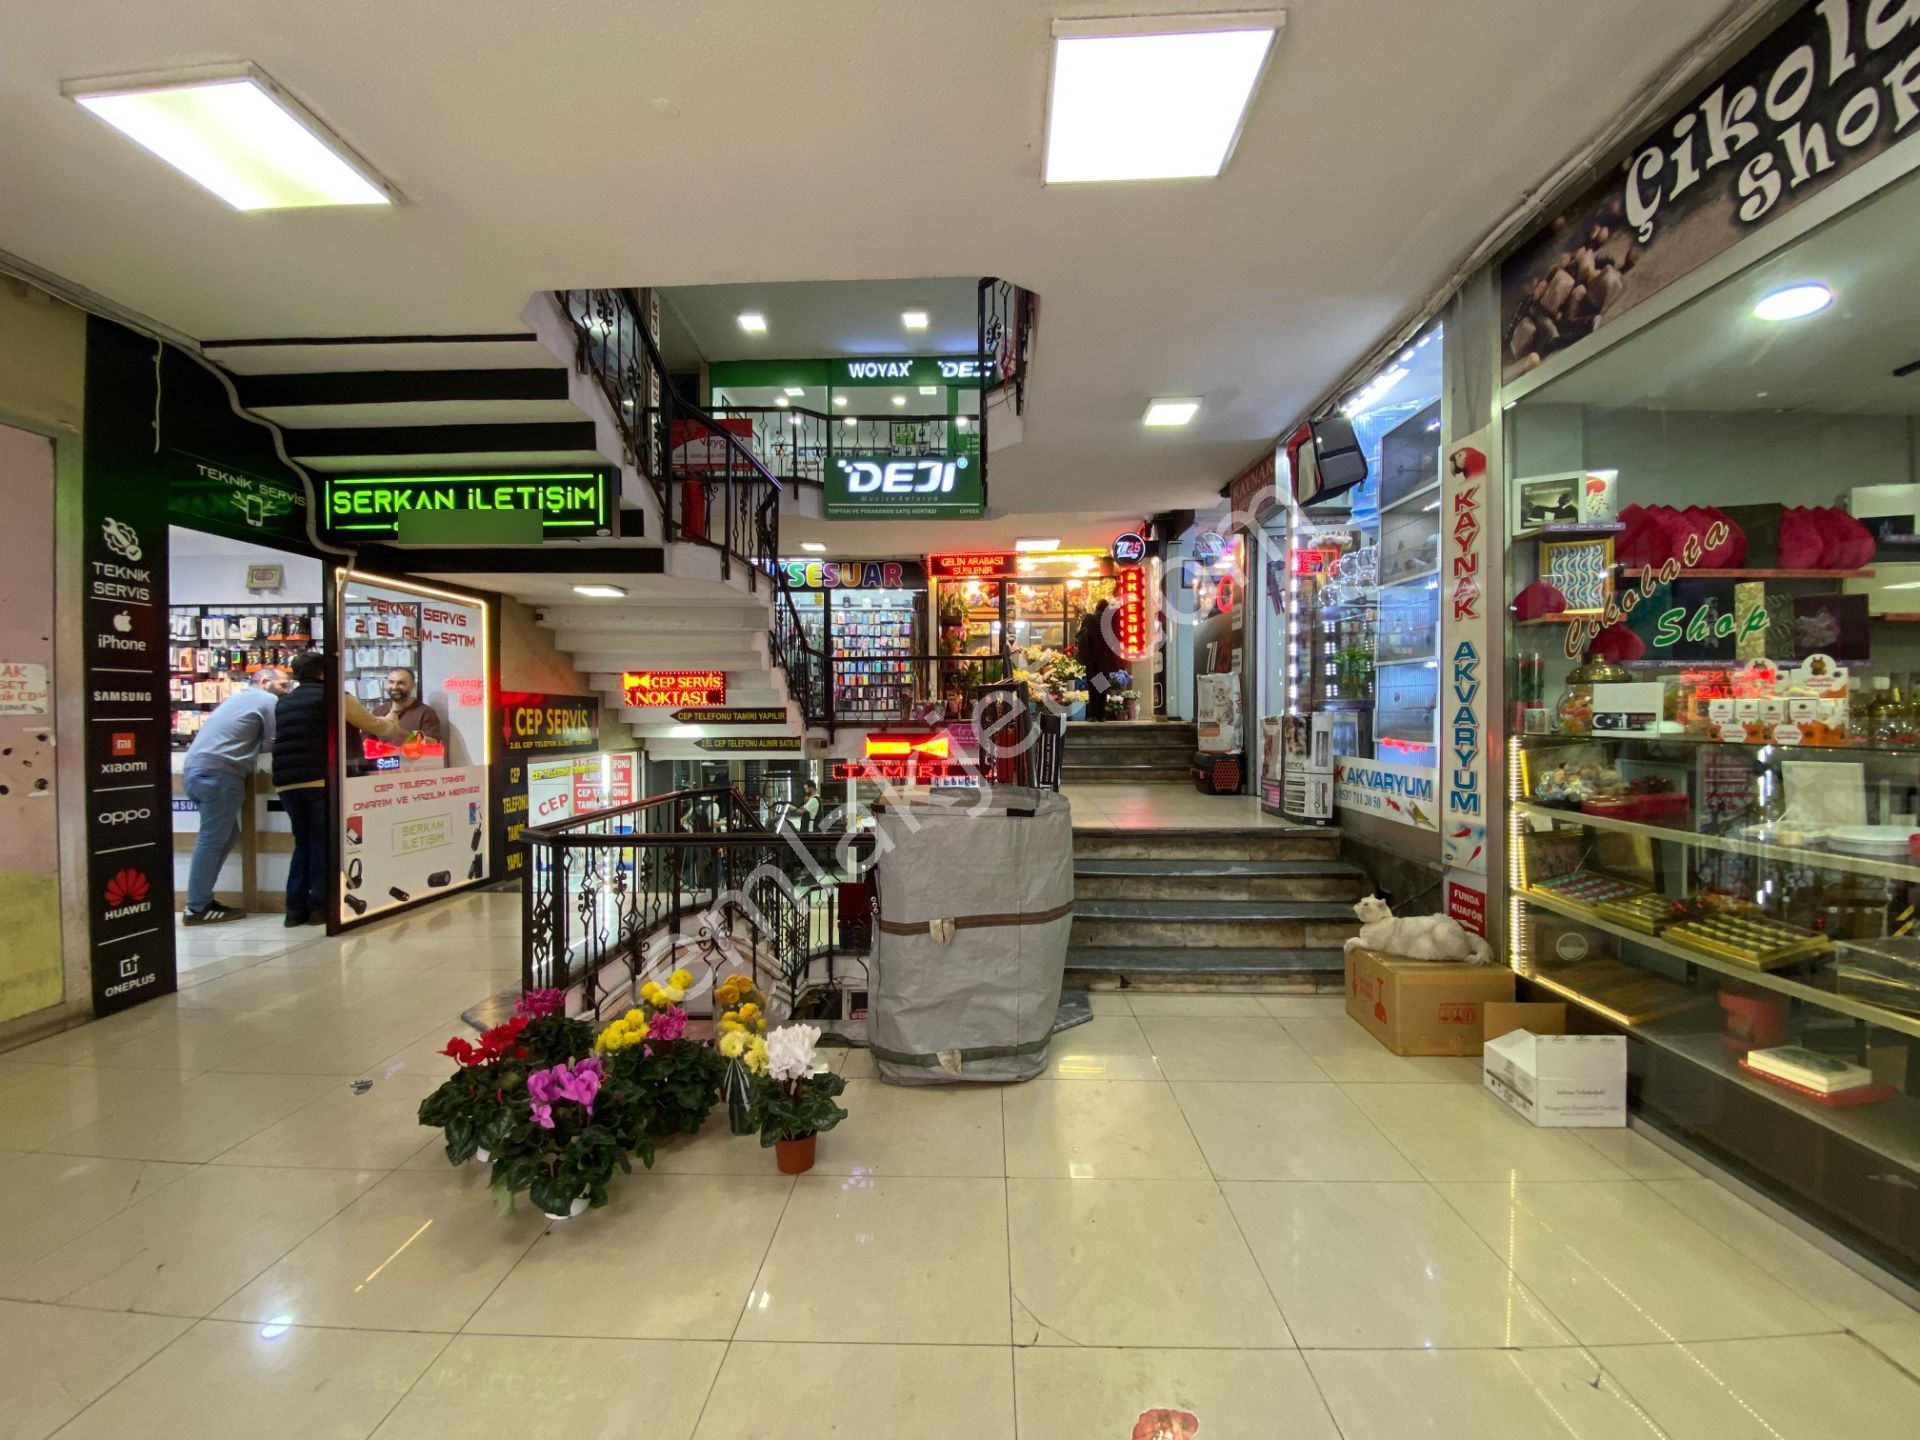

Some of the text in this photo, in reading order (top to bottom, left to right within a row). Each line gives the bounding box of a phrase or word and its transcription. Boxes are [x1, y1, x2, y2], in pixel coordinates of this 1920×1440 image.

[848, 360, 913, 379] WOYAX
[259, 484, 306, 507] SERVİS
[333, 486, 596, 514] SERKAN İLETİŞİM
[1453, 486, 1479, 620] KAYNAK
[92, 561, 151, 583] TEKNİK
[93, 581, 150, 601] SERVİS
[367, 597, 467, 627] TEKNİK SERVİS
[1127, 572, 1138, 654] AKSESUAR
[376, 622, 394, 637] EL
[1653, 604, 1770, 648] Shop
[98, 634, 147, 651] iPhone
[651, 673, 721, 688] CEP SERVİS
[93, 691, 152, 702] SAMSUNG
[636, 692, 708, 704] NOKTASI
[516, 704, 588, 736] CEP SERVİS
[678, 712, 692, 720] CEP
[694, 712, 732, 720] TELEFONU
[1450, 640, 1480, 816] AKVARYUM
[715, 740, 726, 748] CEP
[728, 740, 758, 748] TELEFONU
[510, 768, 520, 784] CEP
[1346, 767, 1433, 801] AKVARYUM
[374, 783, 394, 793] CEP
[399, 779, 437, 790] TELEFON
[577, 788, 591, 798] CEP
[396, 796, 408, 805] VE
[538, 793, 569, 816] CEP
[99, 808, 151, 825] oppo
[402, 820, 444, 837] SERKAN
[1453, 889, 1480, 906] FUNDA
[104, 902, 151, 920] HUAWEI
[1452, 903, 1484, 923] KUAFÖR
[105, 973, 156, 997] ONEPLUS
